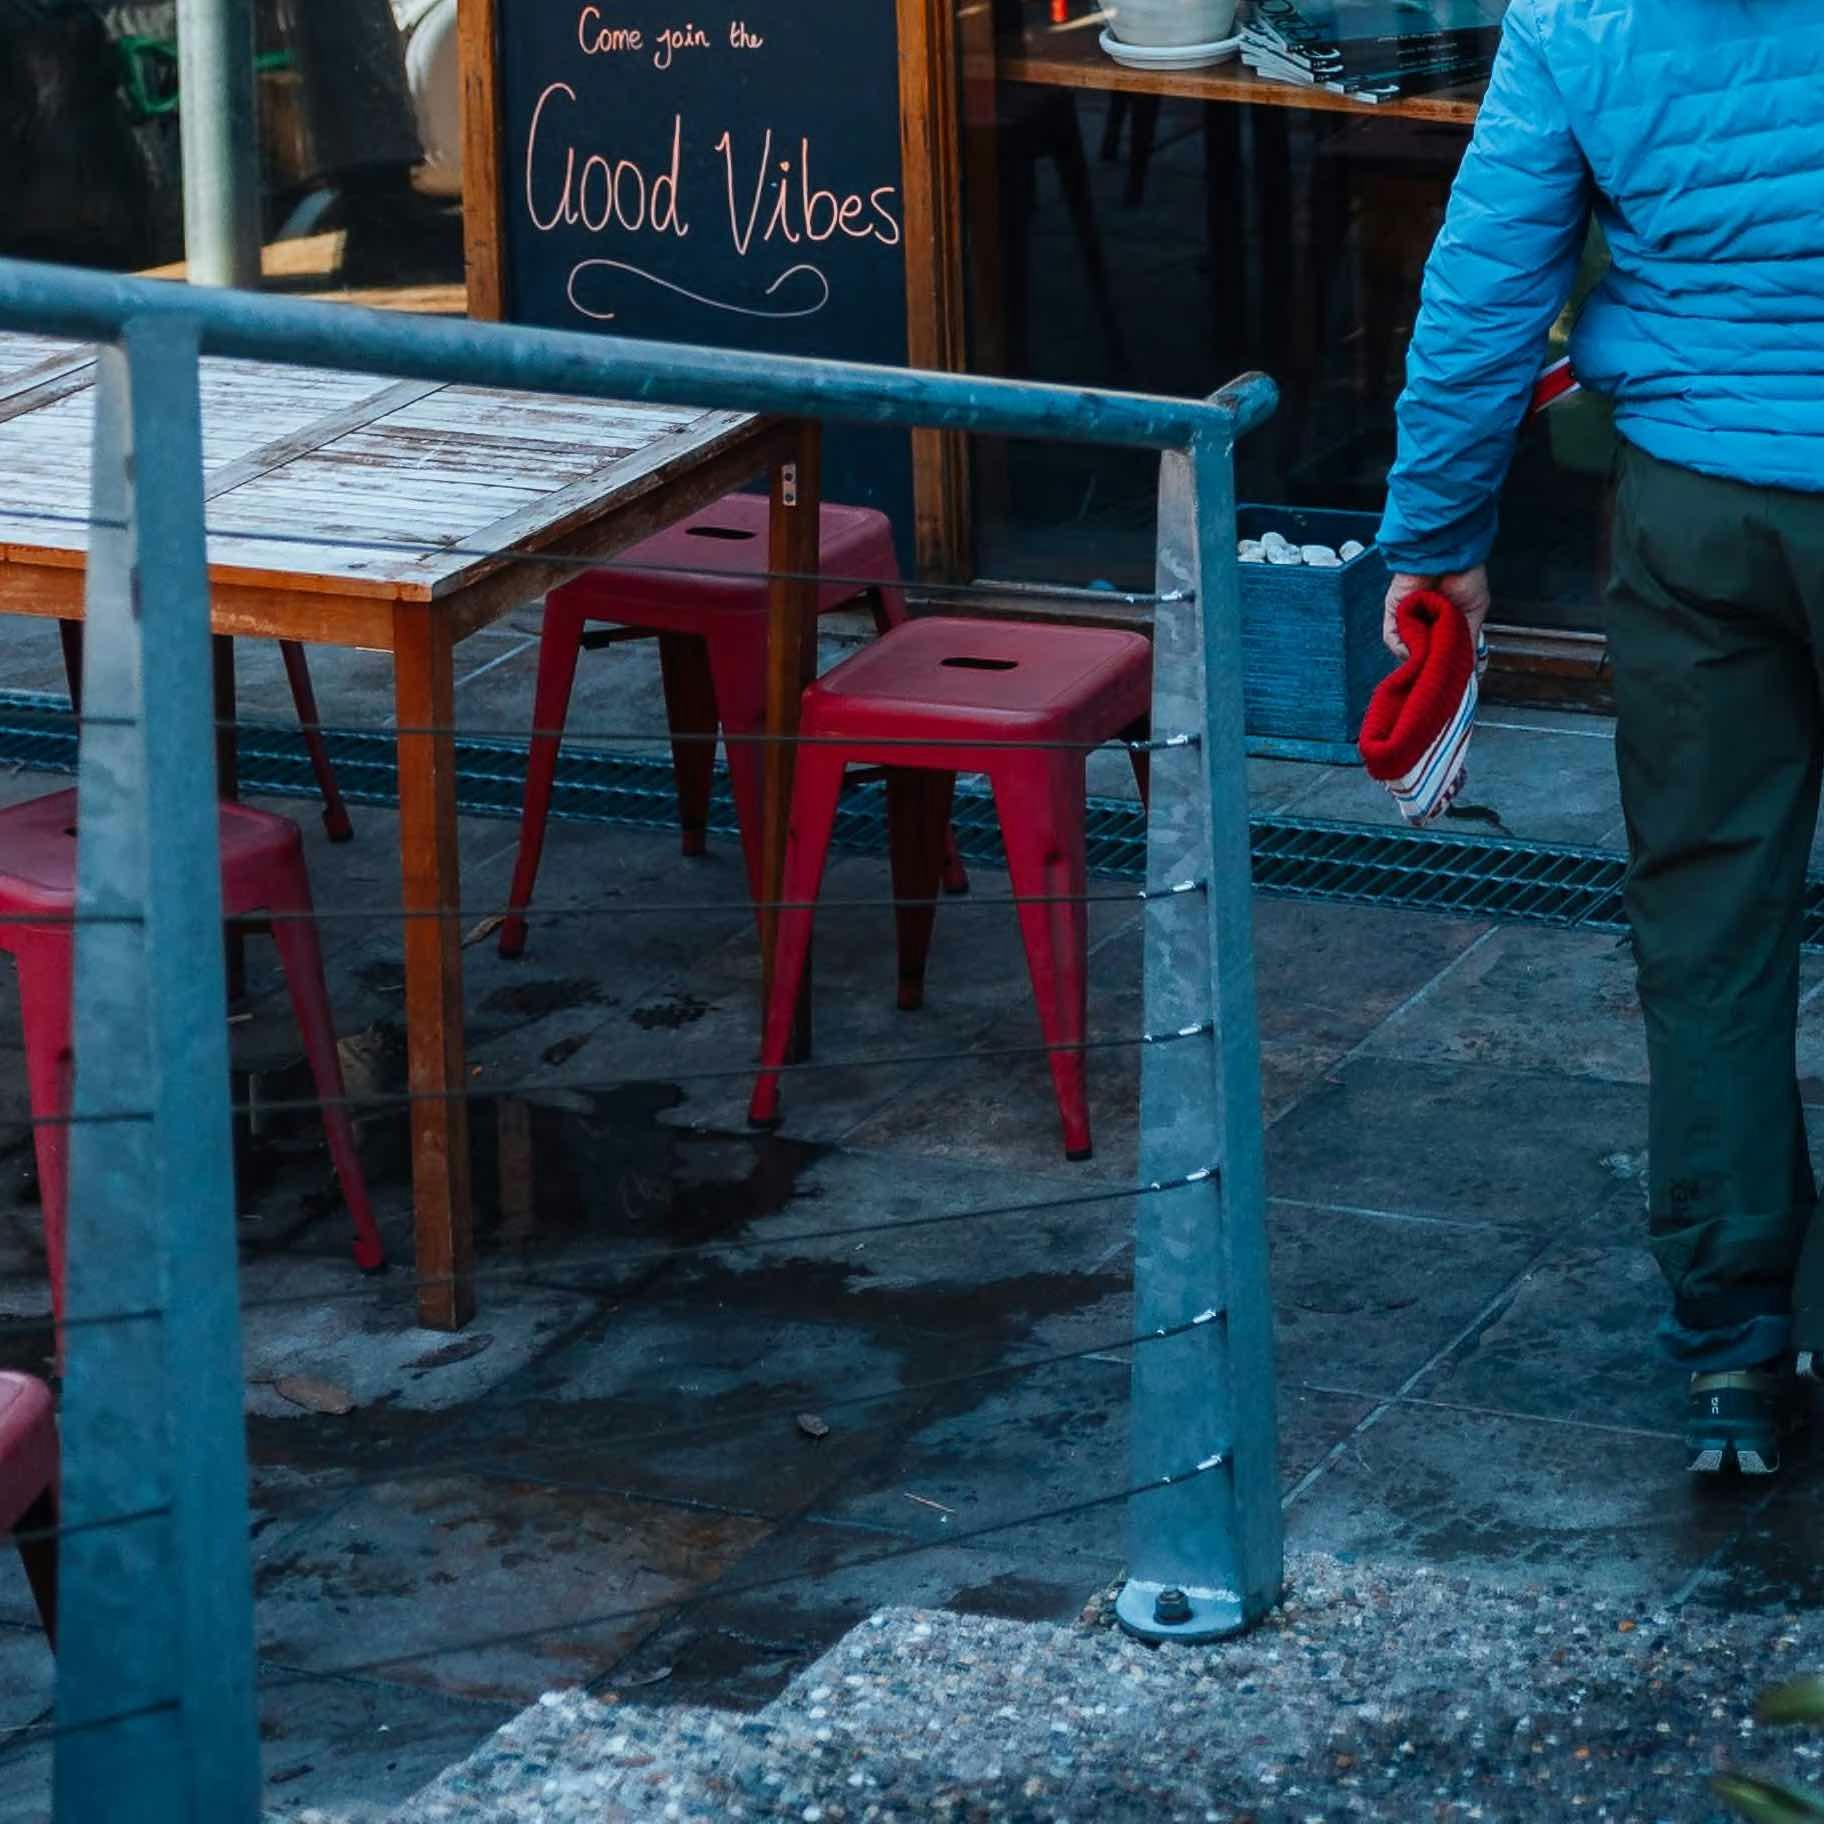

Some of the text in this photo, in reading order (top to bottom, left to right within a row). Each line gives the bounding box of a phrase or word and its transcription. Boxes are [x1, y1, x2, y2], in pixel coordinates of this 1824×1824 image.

[577, 5, 764, 69] Come join the
[525, 82, 901, 254] Good Vibes
